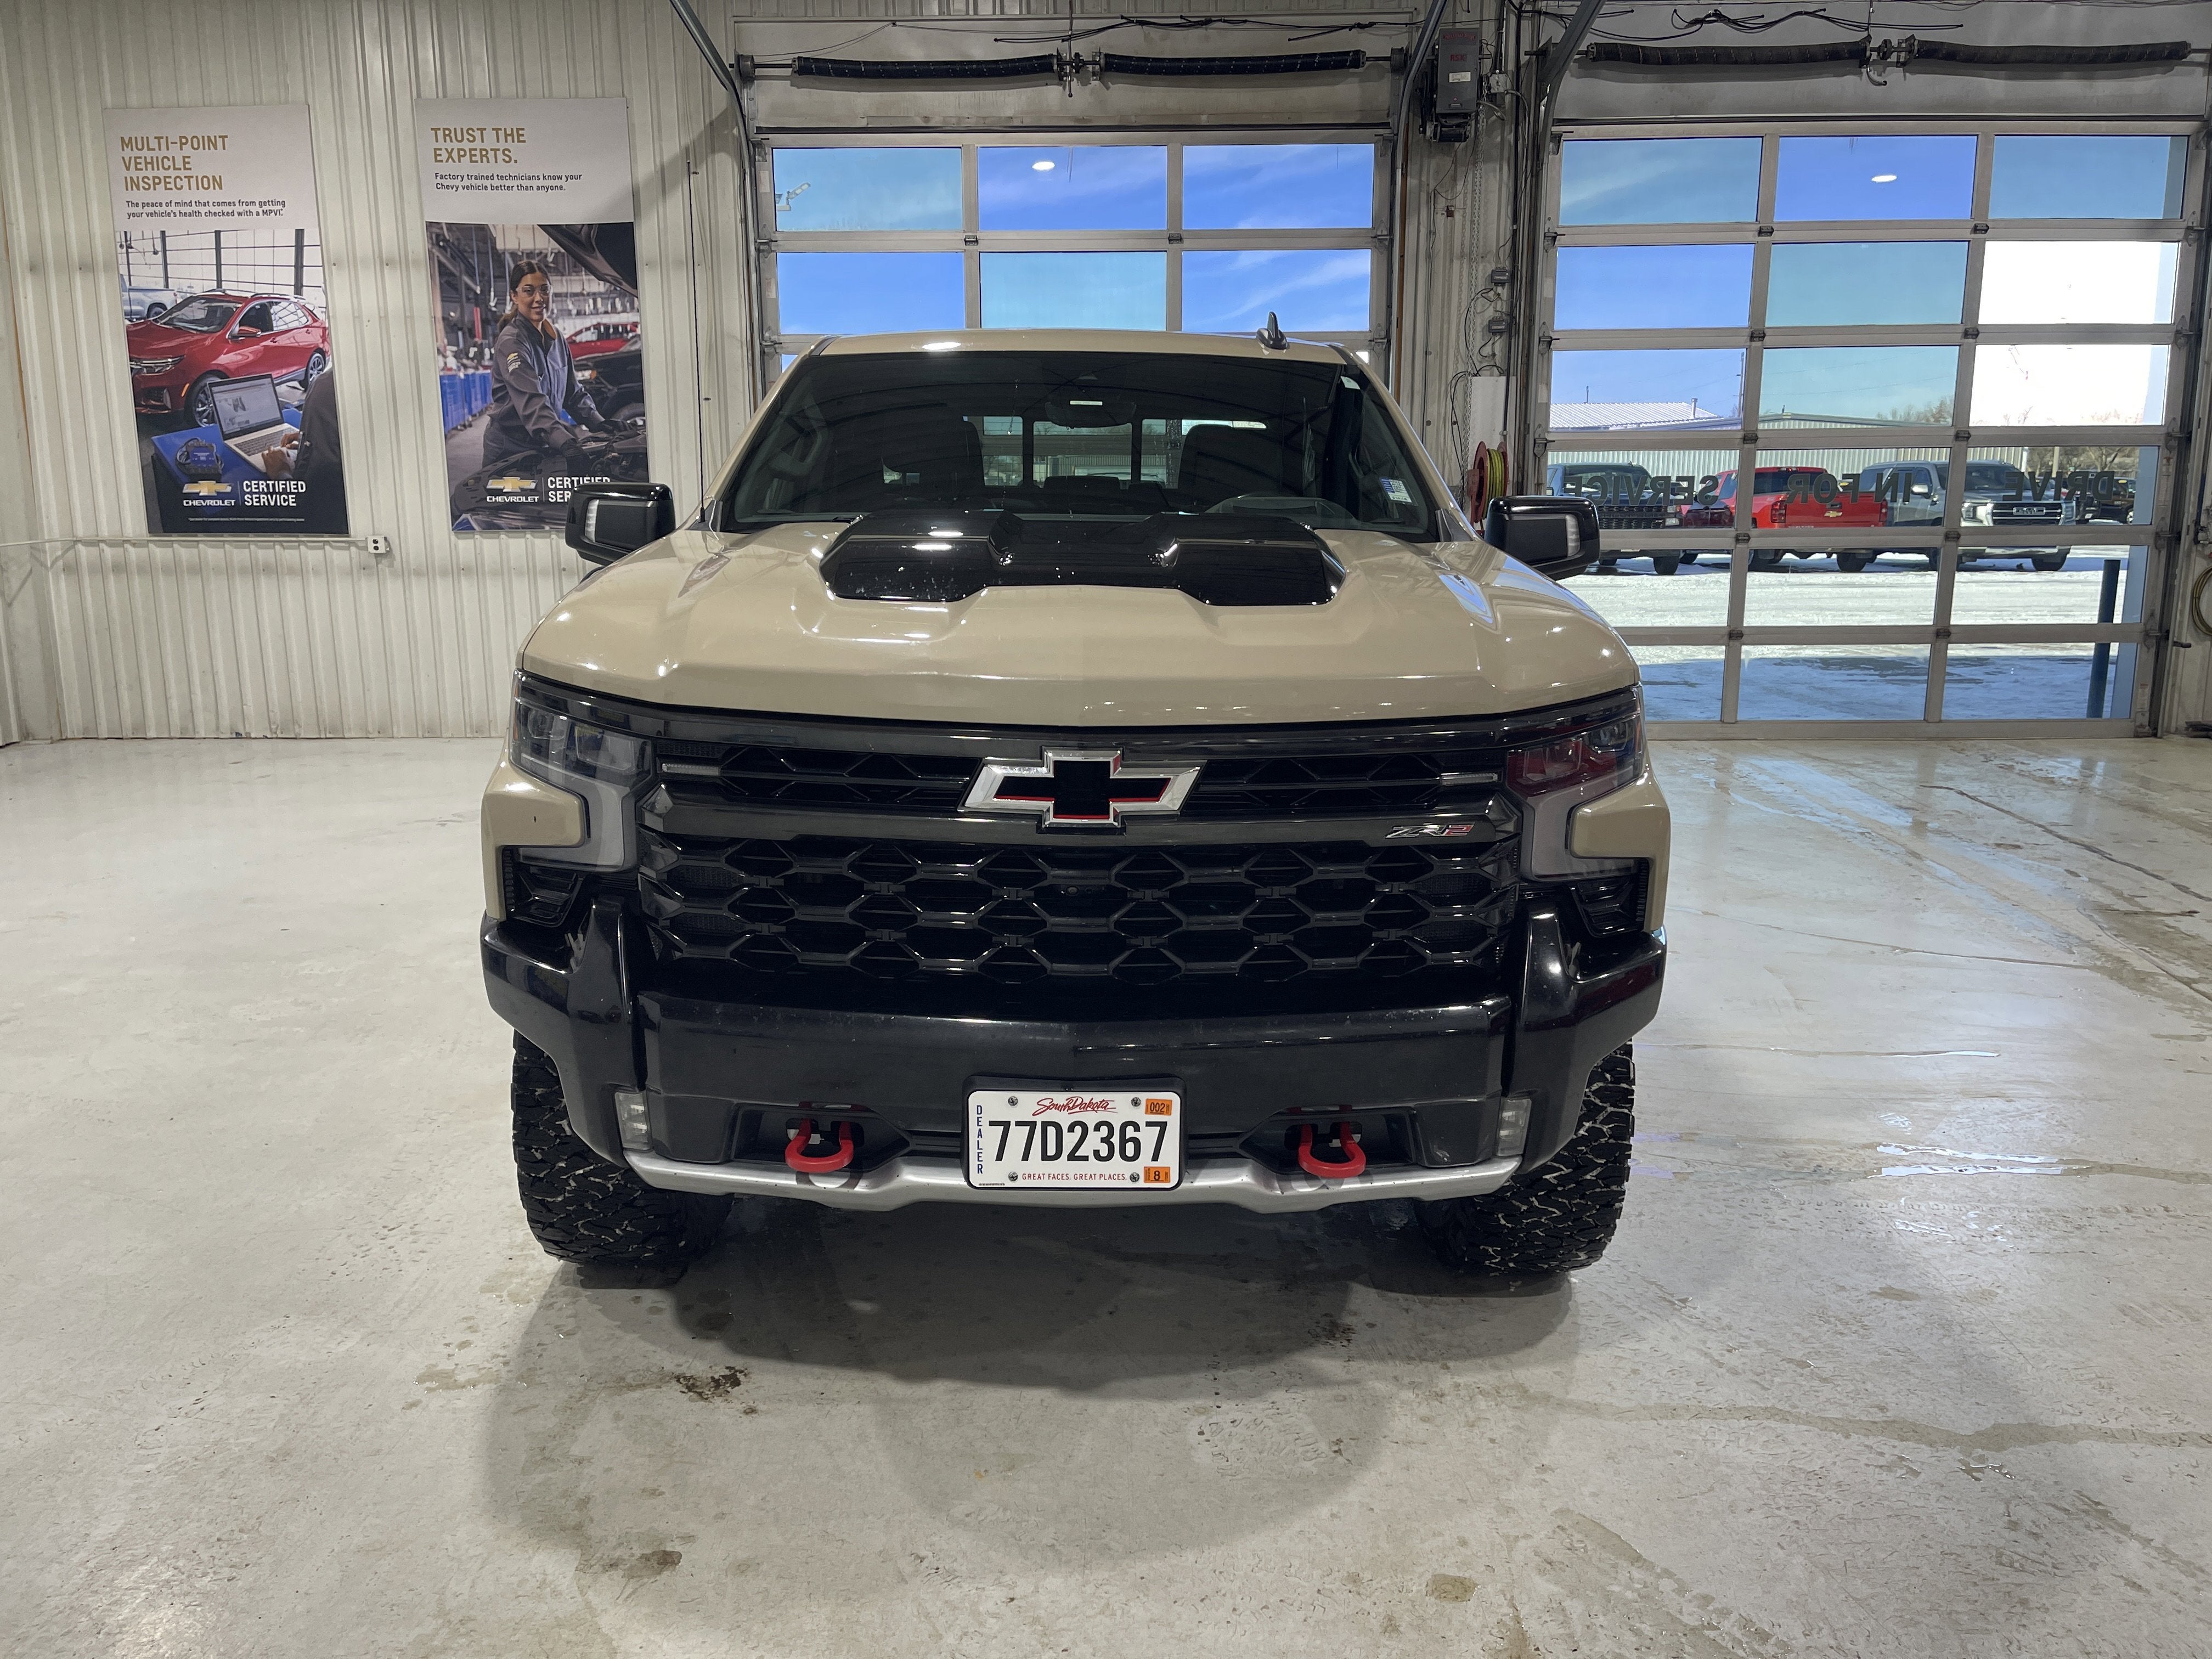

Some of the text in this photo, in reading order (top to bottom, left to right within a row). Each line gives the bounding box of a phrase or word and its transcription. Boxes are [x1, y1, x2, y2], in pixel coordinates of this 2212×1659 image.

[431, 127, 526, 143] TRUST THE
[120, 135, 228, 151] MULTI-POINT
[122, 155, 192, 171] VEHICLE
[433, 148, 518, 163] EXPERTS.
[124, 175, 223, 191] INSPECTION
[435, 172, 465, 182] Factory
[565, 174, 582, 182] your
[436, 183, 459, 191] Chevy
[258, 199, 285, 208] getting
[243, 481, 306, 493] CERTIFIED
[245, 494, 296, 506] SERVICE
[1384, 822, 1475, 839] ZR2
[1032, 1096, 1118, 1116] South Dakota
[1150, 1102, 1165, 1113] 002
[989, 1120, 1167, 1162] 77D2367
[1154, 1170, 1160, 1181] 8
